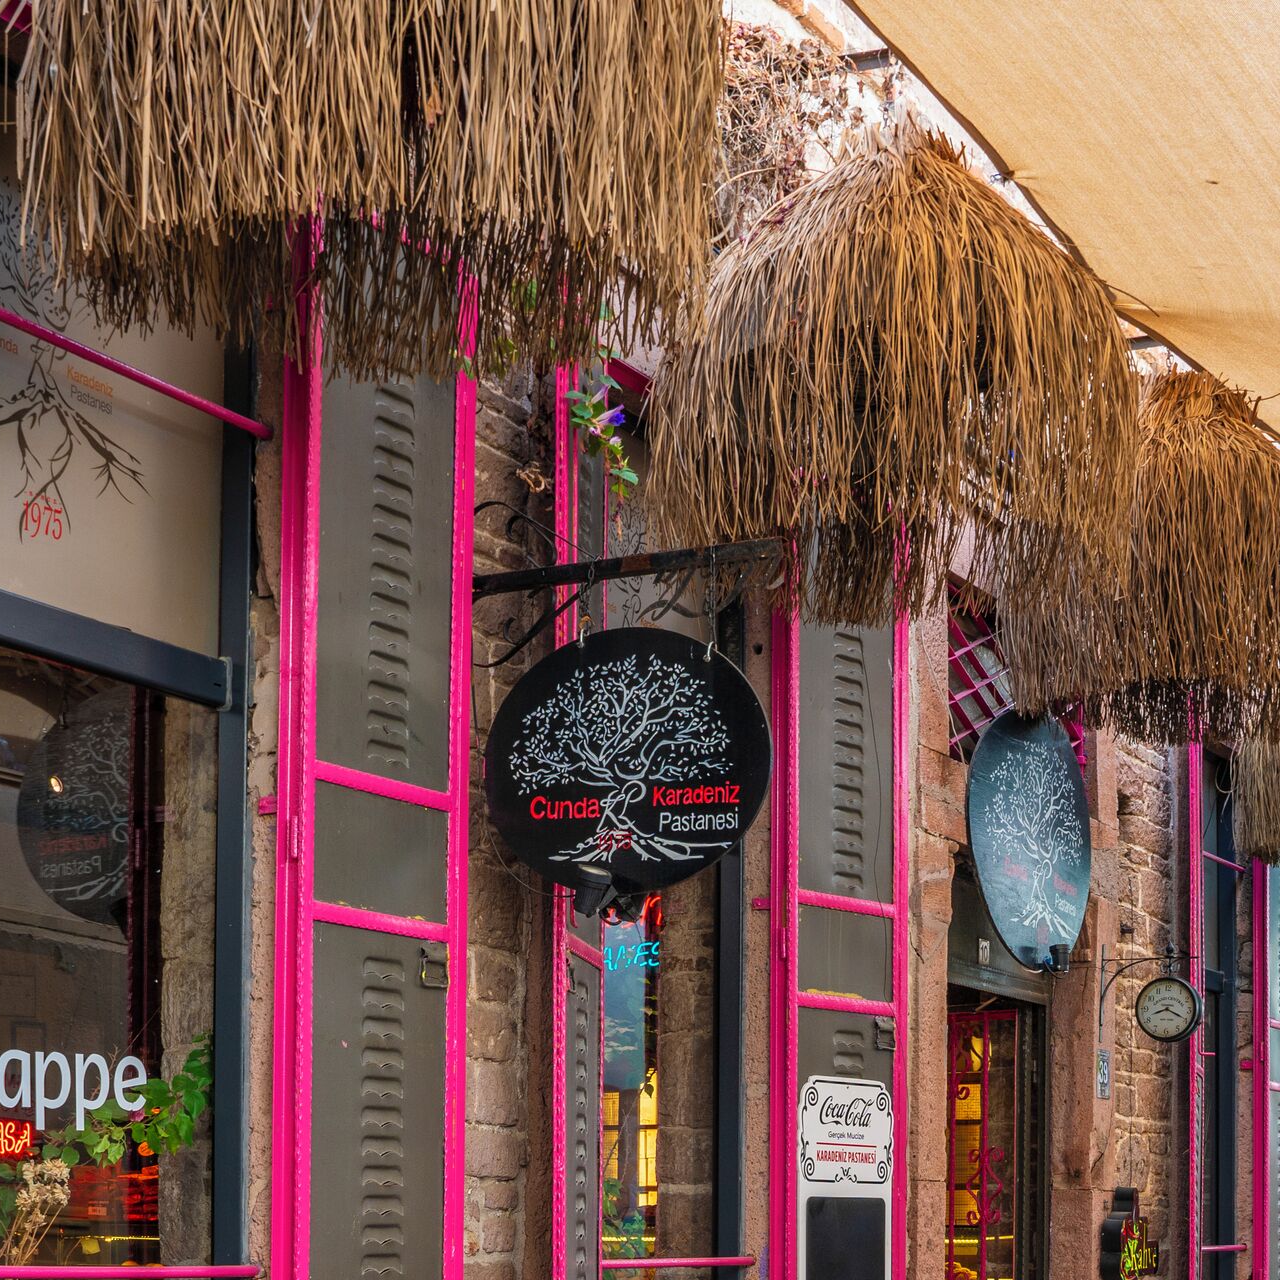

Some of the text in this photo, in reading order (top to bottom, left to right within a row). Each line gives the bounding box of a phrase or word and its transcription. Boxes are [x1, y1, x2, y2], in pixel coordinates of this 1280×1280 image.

[66, 364, 113, 398] Karadeniz
[70, 384, 113, 415] Pastanesi
[23, 500, 62, 540] 1975
[529, 781, 741, 820] Cunda Karadeniz
[659, 807, 739, 832] Pastanesi
[1099, 1060, 1108, 1084] 39
[820, 1096, 874, 1127] Coca-Cola
[816, 1149, 877, 1164] KARADENİZ PASTANESİ
